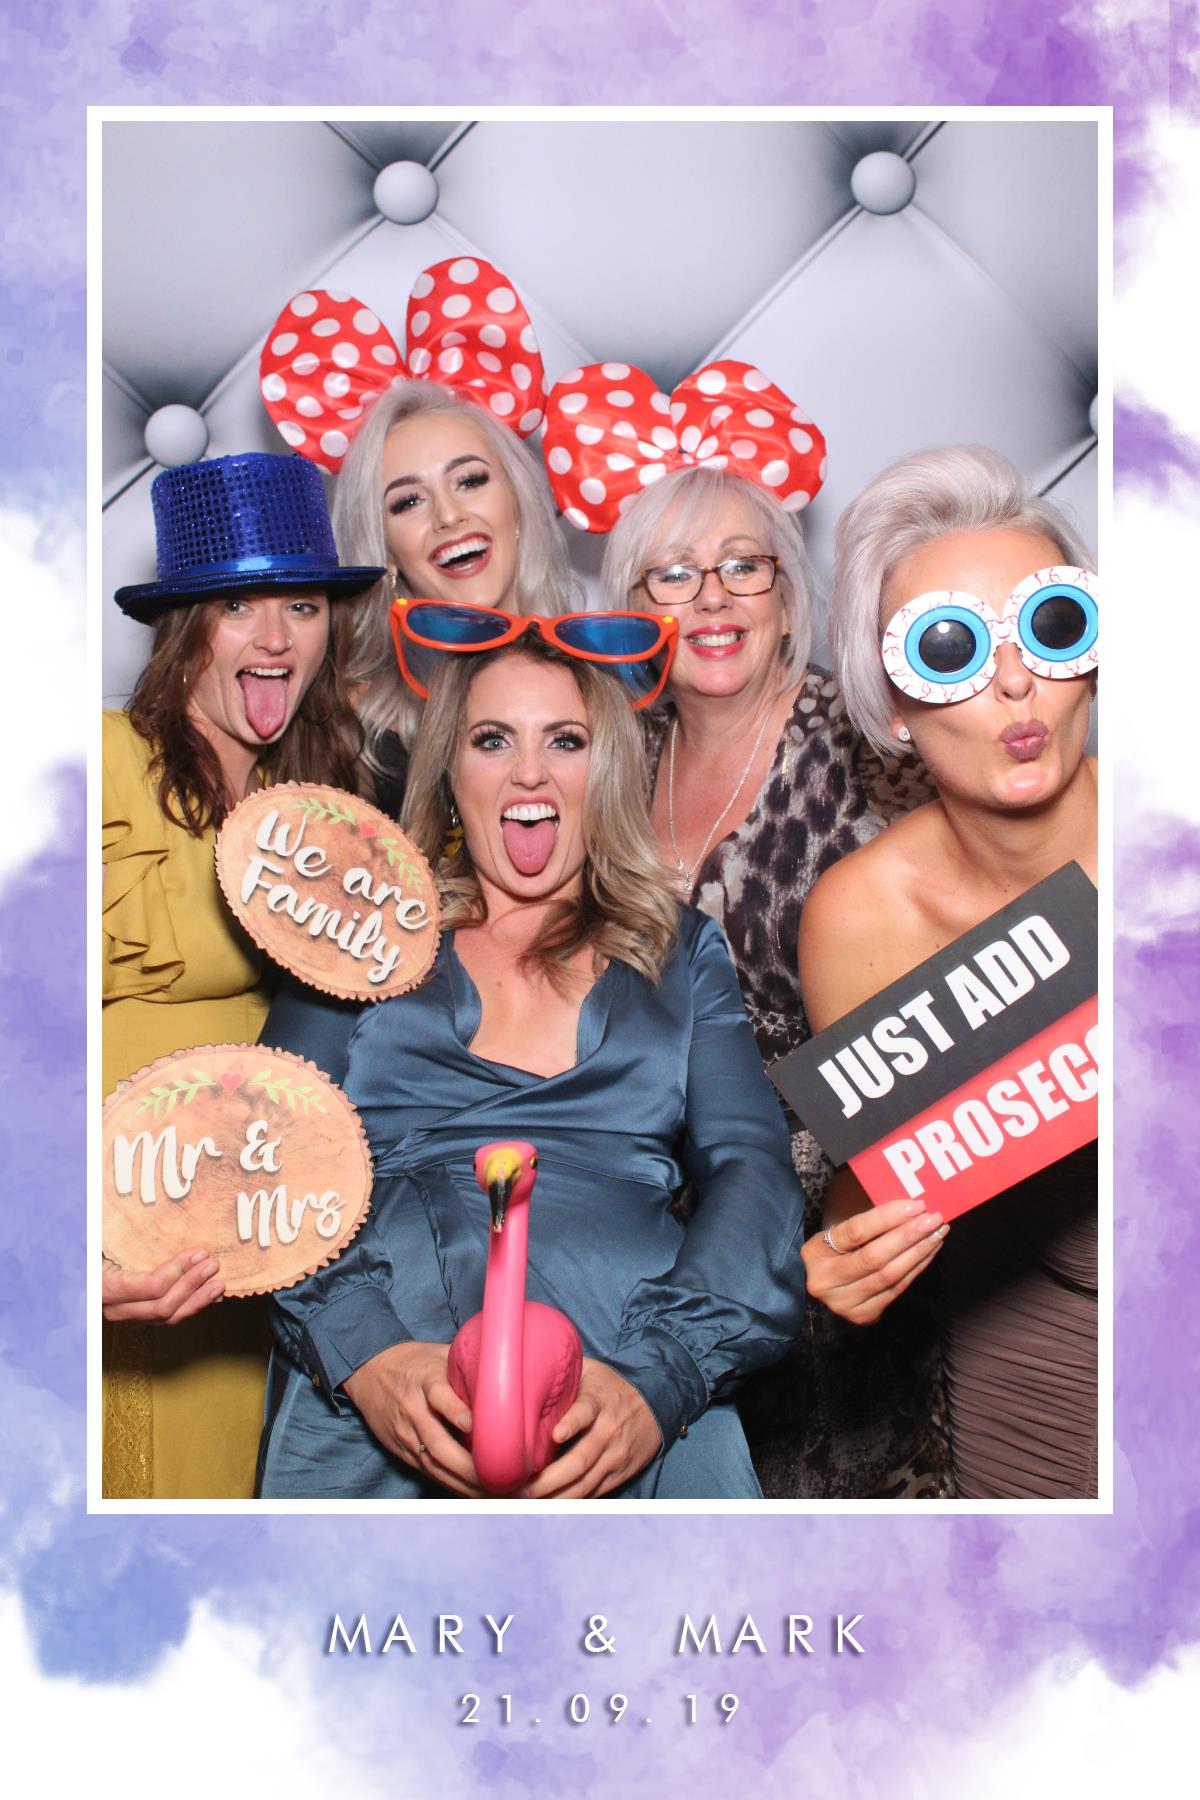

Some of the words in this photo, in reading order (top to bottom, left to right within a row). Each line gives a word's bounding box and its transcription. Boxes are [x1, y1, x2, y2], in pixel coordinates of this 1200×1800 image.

[241, 855, 403, 983] Family
[255, 809, 332, 878] We
[343, 868, 432, 930] are
[817, 990, 955, 1119] JUST
[944, 915, 1071, 1031] ADD
[114, 1125, 223, 1203] Mr
[239, 1120, 282, 1173] &
[882, 1023, 1098, 1199] PROSEC
[237, 1184, 347, 1247] Mrs
